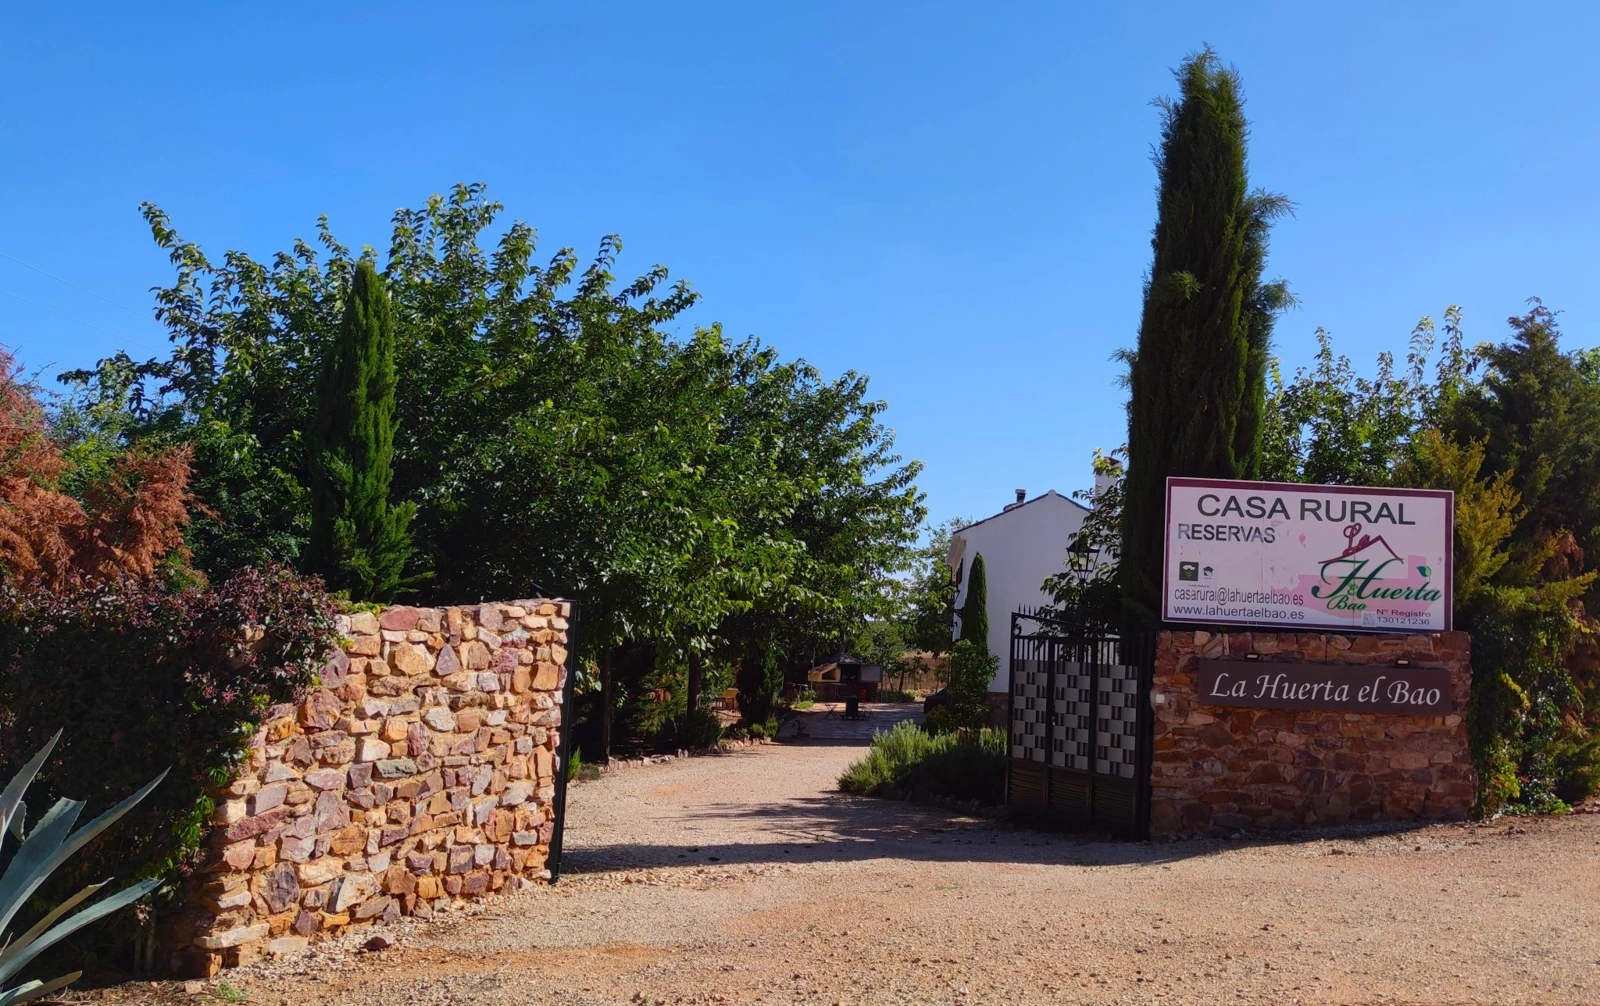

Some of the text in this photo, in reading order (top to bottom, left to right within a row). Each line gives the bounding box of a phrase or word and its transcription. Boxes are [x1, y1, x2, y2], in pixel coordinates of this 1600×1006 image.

[1197, 494, 1416, 525] CASA RURAL
[1178, 523, 1275, 543] RESERVAS
[1311, 558, 1442, 601] Huerta
[1326, 595, 1368, 611] Bao
[1173, 605, 1304, 620] www.lahuertaelbao.es
[1377, 616, 1430, 625] 130121236
[1391, 609, 1431, 618] Registro
[1210, 672, 1441, 706] La Huerta el Bao
